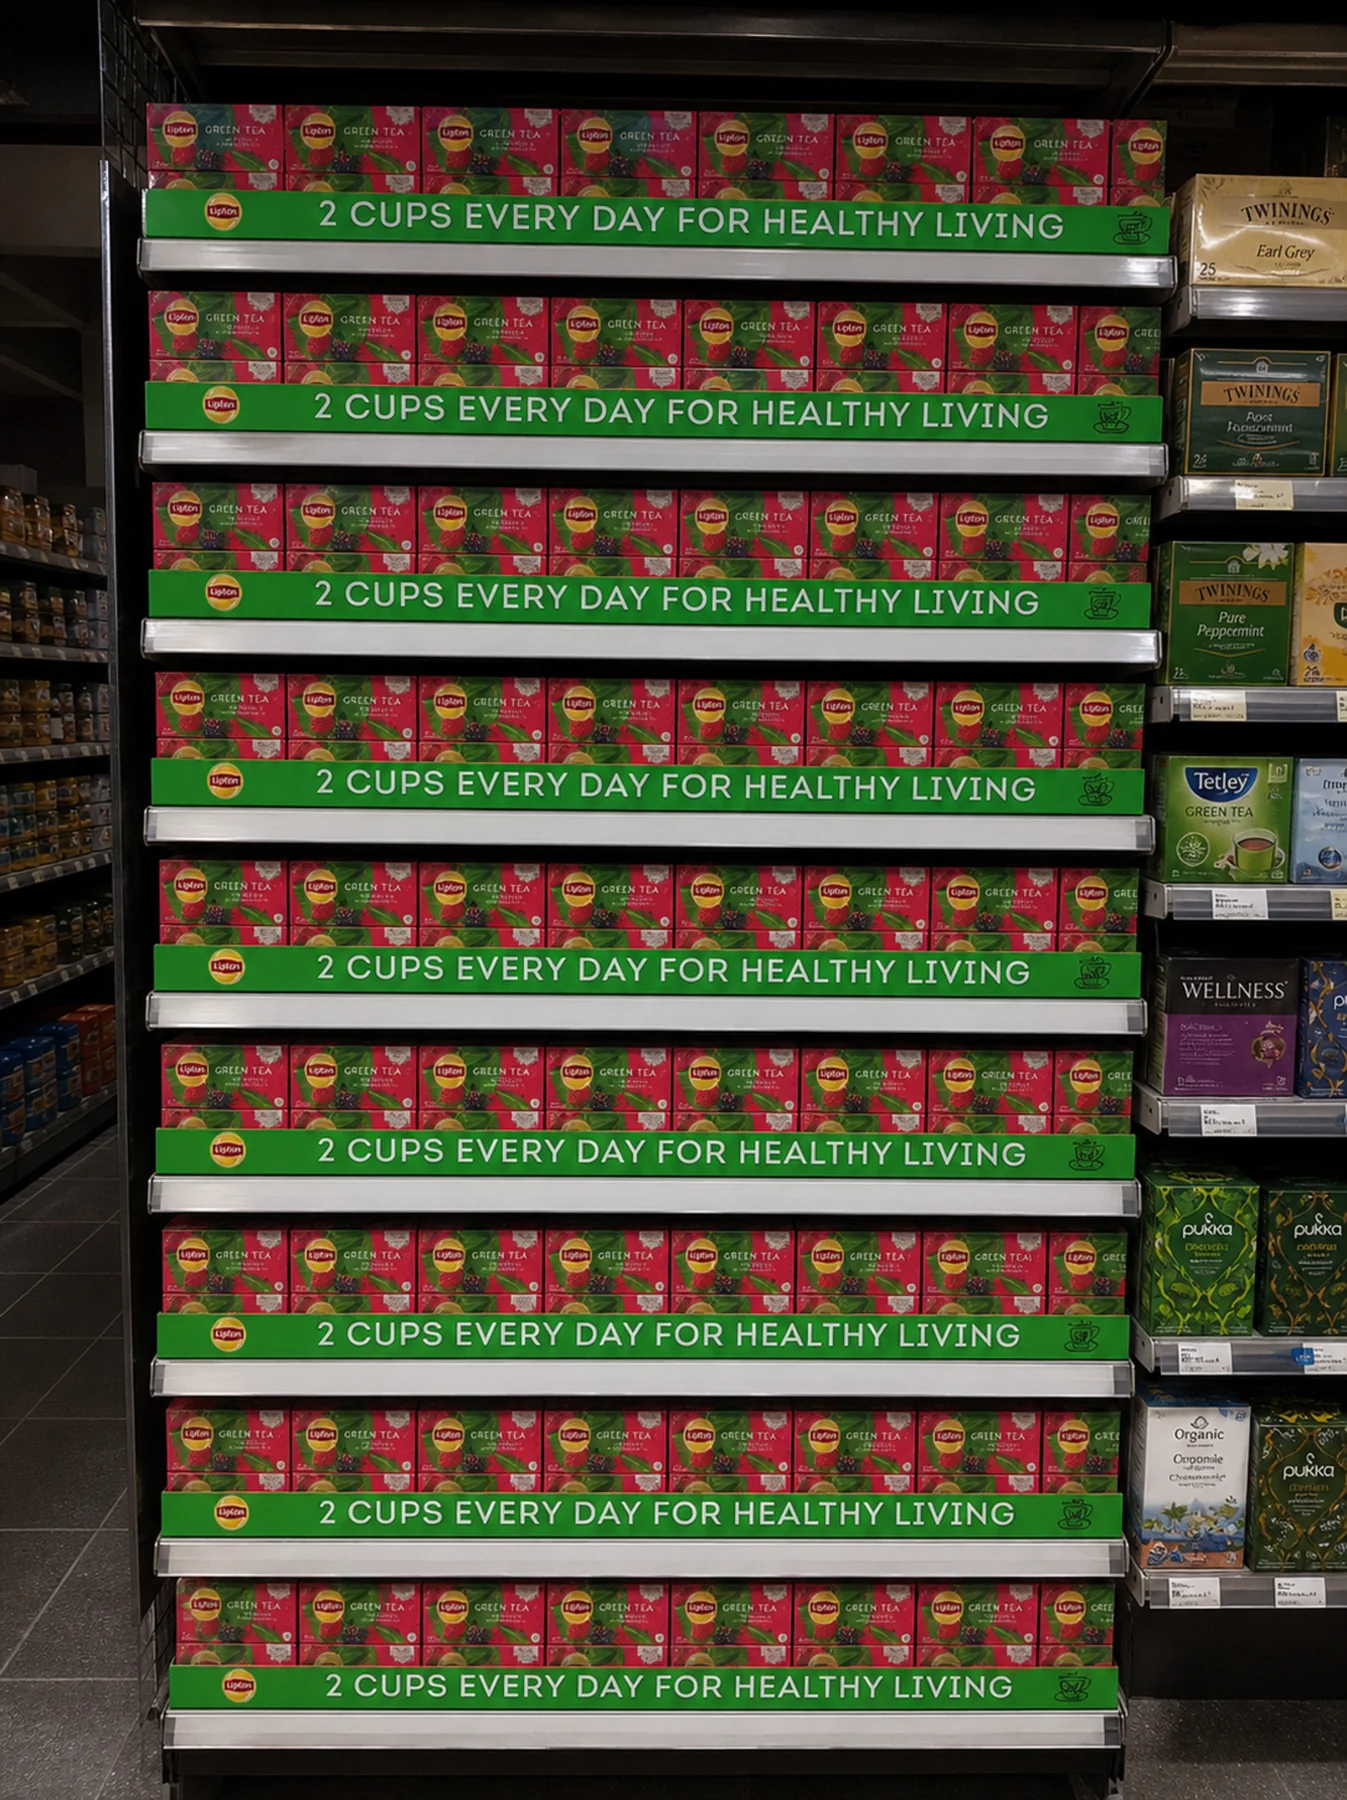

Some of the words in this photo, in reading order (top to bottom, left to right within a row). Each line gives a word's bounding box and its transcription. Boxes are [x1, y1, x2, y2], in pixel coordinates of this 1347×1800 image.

[381, 126, 405, 137] TEA
[658, 131, 682, 142] TEA
[1071, 138, 1093, 150] TEA
[319, 199, 337, 226] 2
[350, 200, 451, 229] CUPS
[466, 202, 581, 231] EVERY
[593, 205, 665, 232] DAY
[678, 206, 750, 234] FOR
[764, 208, 924, 237] HEALTHY
[936, 211, 1064, 240] LIVING
[1240, 201, 1332, 225] TWININGS
[1256, 244, 1282, 259] Earl
[1285, 245, 1315, 263] Grey
[1200, 262, 1216, 276] 25
[512, 317, 532, 328] TEA
[1041, 325, 1063, 336] TEA
[1223, 383, 1300, 403] TWININGS
[314, 392, 332, 419] 2
[345, 393, 445, 421] CUPS
[459, 395, 572, 423] EVERY
[584, 397, 656, 424] DAY
[668, 398, 739, 425] FOR
[752, 399, 911, 427] HEALTHY
[922, 401, 1049, 429] LIVING
[379, 506, 400, 516] TEA
[901, 513, 923, 523] TEA
[315, 580, 333, 606] 2
[345, 580, 444, 608] CUPS
[457, 582, 568, 610] EVERY
[580, 584, 650, 611] DAY
[663, 586, 732, 612] FOR
[745, 587, 902, 614] HEALTHY
[914, 588, 1039, 616] LIVING
[1195, 583, 1270, 603] TWININGS
[1218, 611, 1246, 624] Pure
[510, 697, 531, 708] TEA
[1027, 703, 1049, 713] TEA
[316, 768, 334, 794] 2
[346, 769, 444, 796] CUPS
[458, 770, 568, 797] EVERY
[580, 772, 650, 798] DAY
[662, 773, 731, 799] FOR
[745, 774, 901, 800] HEALTHY
[912, 776, 1036, 802] LIVING
[1194, 772, 1249, 794] Tetley
[1185, 806, 1227, 818] GREEN
[1232, 806, 1254, 818] TEA
[509, 883, 530, 893] TEA
[894, 887, 914, 897] TEA
[317, 954, 334, 979] 2
[346, 954, 444, 980] CUPS
[457, 955, 567, 981] EVERY
[579, 956, 648, 982] DAY
[660, 957, 729, 983] FOR
[742, 958, 896, 984] HEALTHY
[907, 959, 1030, 985] LIVING
[1182, 982, 1286, 1000] WELLNESS
[509, 1066, 530, 1076] TEA
[891, 1069, 911, 1079] TEA
[318, 1137, 335, 1162] 2
[347, 1137, 444, 1163] CUPS
[457, 1138, 566, 1163] EVERY
[577, 1139, 646, 1164] DAY
[658, 1139, 726, 1165] FOR
[739, 1140, 893, 1165] HEALTHY
[904, 1141, 1026, 1167] LIVING
[1182, 1223, 1233, 1239] pukka
[1294, 1223, 1343, 1239] pukka
[380, 1250, 400, 1260] TEA
[632, 1250, 653, 1260] TEA
[317, 1321, 335, 1346] 2
[347, 1321, 443, 1347] CUPS
[456, 1321, 564, 1346] EVERY
[576, 1321, 644, 1346] DAY
[656, 1321, 724, 1347] FOR
[736, 1322, 888, 1347] HEALTHY
[899, 1322, 1020, 1348] LIVING
[507, 1430, 526, 1440] TEA
[881, 1431, 901, 1441] TEA
[1174, 1428, 1225, 1443] Organic
[1283, 1464, 1335, 1481] pukka
[319, 1499, 336, 1525] 2
[347, 1499, 443, 1525] CUPS
[456, 1500, 563, 1525] EVERY
[574, 1500, 642, 1525] DAY
[653, 1500, 722, 1526] FOR
[734, 1501, 884, 1526] HEALTHY
[895, 1501, 1015, 1526] LIVING
[510, 1603, 529, 1612] TEA
[1003, 1603, 1023, 1613] TEA
[326, 1673, 343, 1697] 2
[354, 1673, 447, 1698] CUPS
[460, 1674, 566, 1698] EVERY
[577, 1674, 644, 1698] DAY
[655, 1674, 723, 1699] FOR
[735, 1675, 884, 1699] HEALTHY
[894, 1675, 1013, 1699] LIVING
